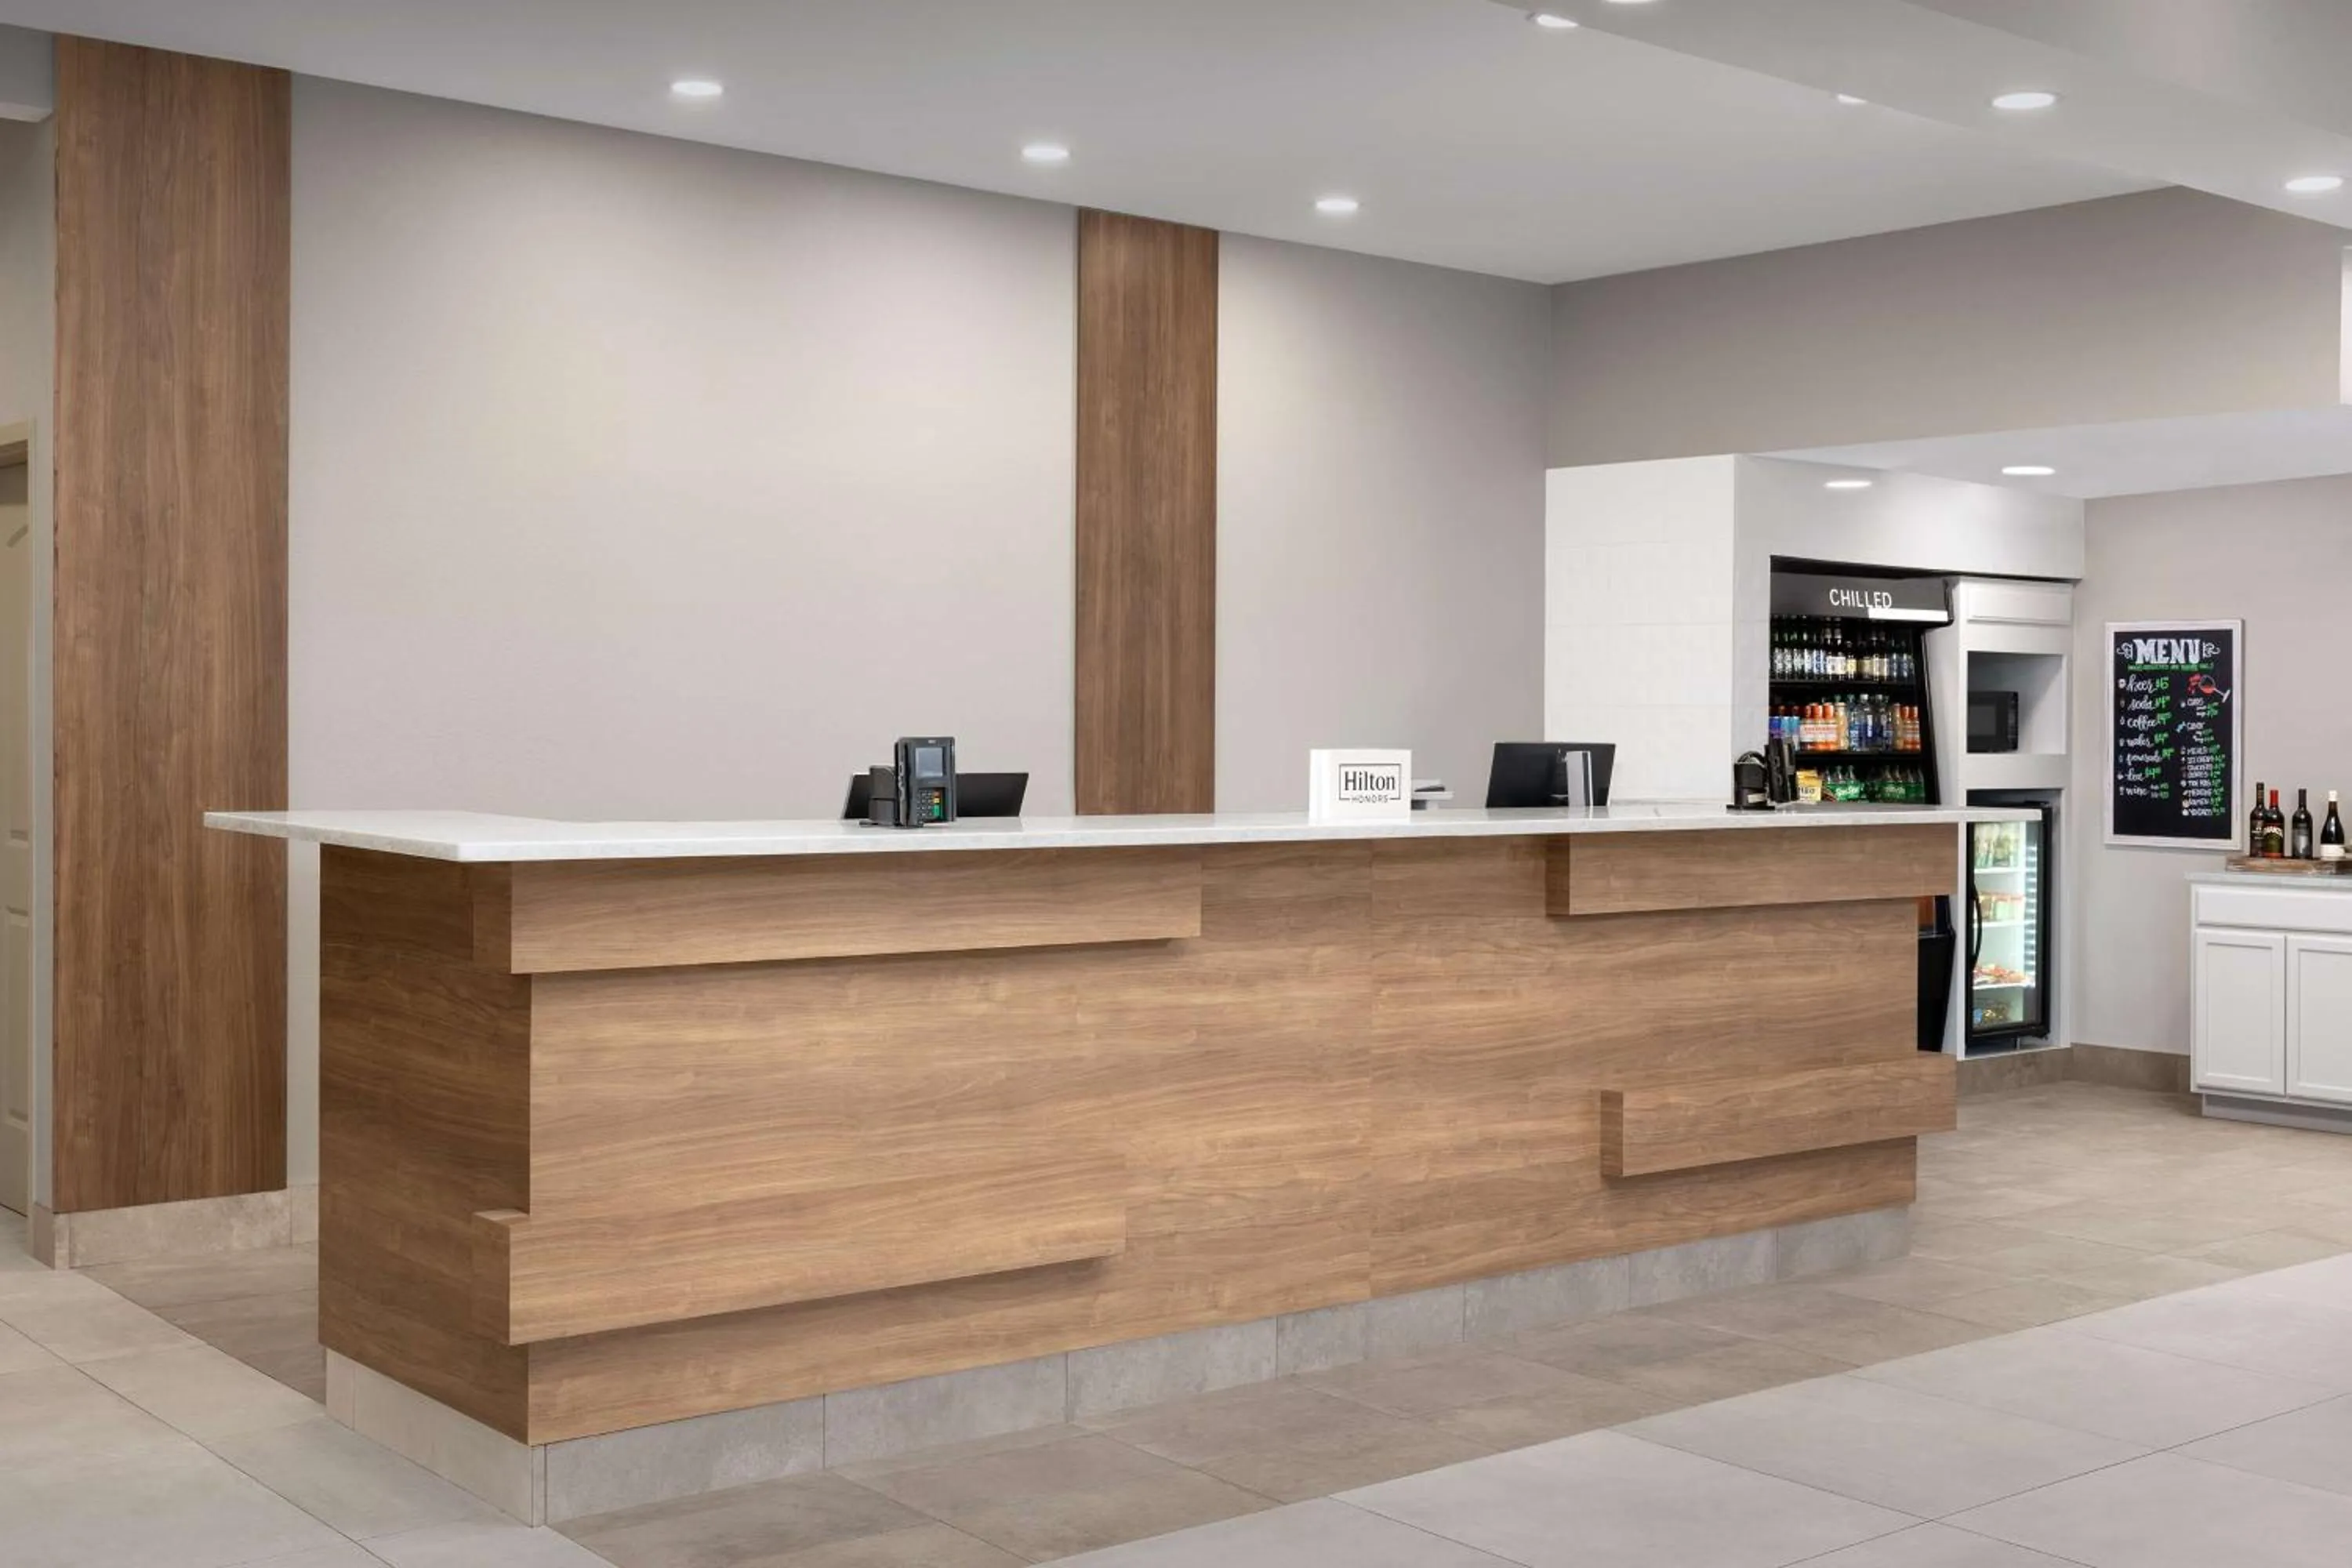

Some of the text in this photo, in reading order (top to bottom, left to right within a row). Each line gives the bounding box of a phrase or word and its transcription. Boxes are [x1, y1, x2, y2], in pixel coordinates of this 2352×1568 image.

[1829, 589, 1892, 609] CHILLED
[2132, 638, 2200, 664] MENU
[2127, 715, 2158, 731] coffee
[1345, 771, 1396, 791] Hilton
[1352, 794, 1389, 804] HONORS
